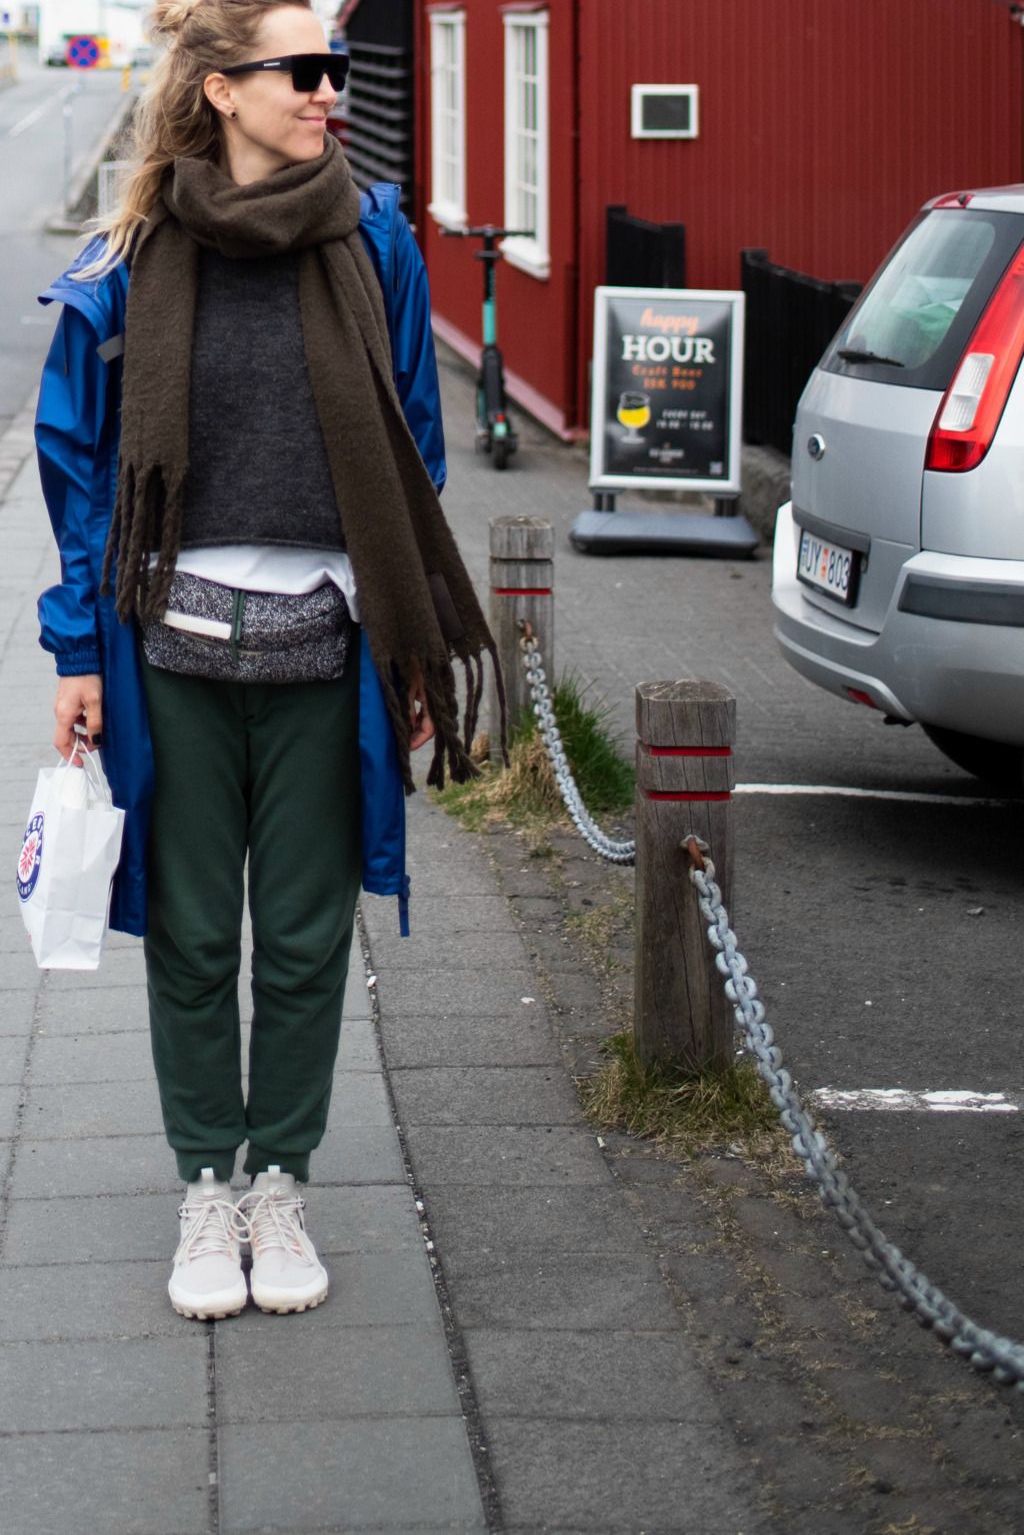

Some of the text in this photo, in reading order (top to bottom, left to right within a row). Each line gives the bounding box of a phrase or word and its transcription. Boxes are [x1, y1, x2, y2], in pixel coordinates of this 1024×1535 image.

[640, 307, 699, 336] happy
[621, 334, 716, 364] HOUR
[828, 550, 850, 591] 803
